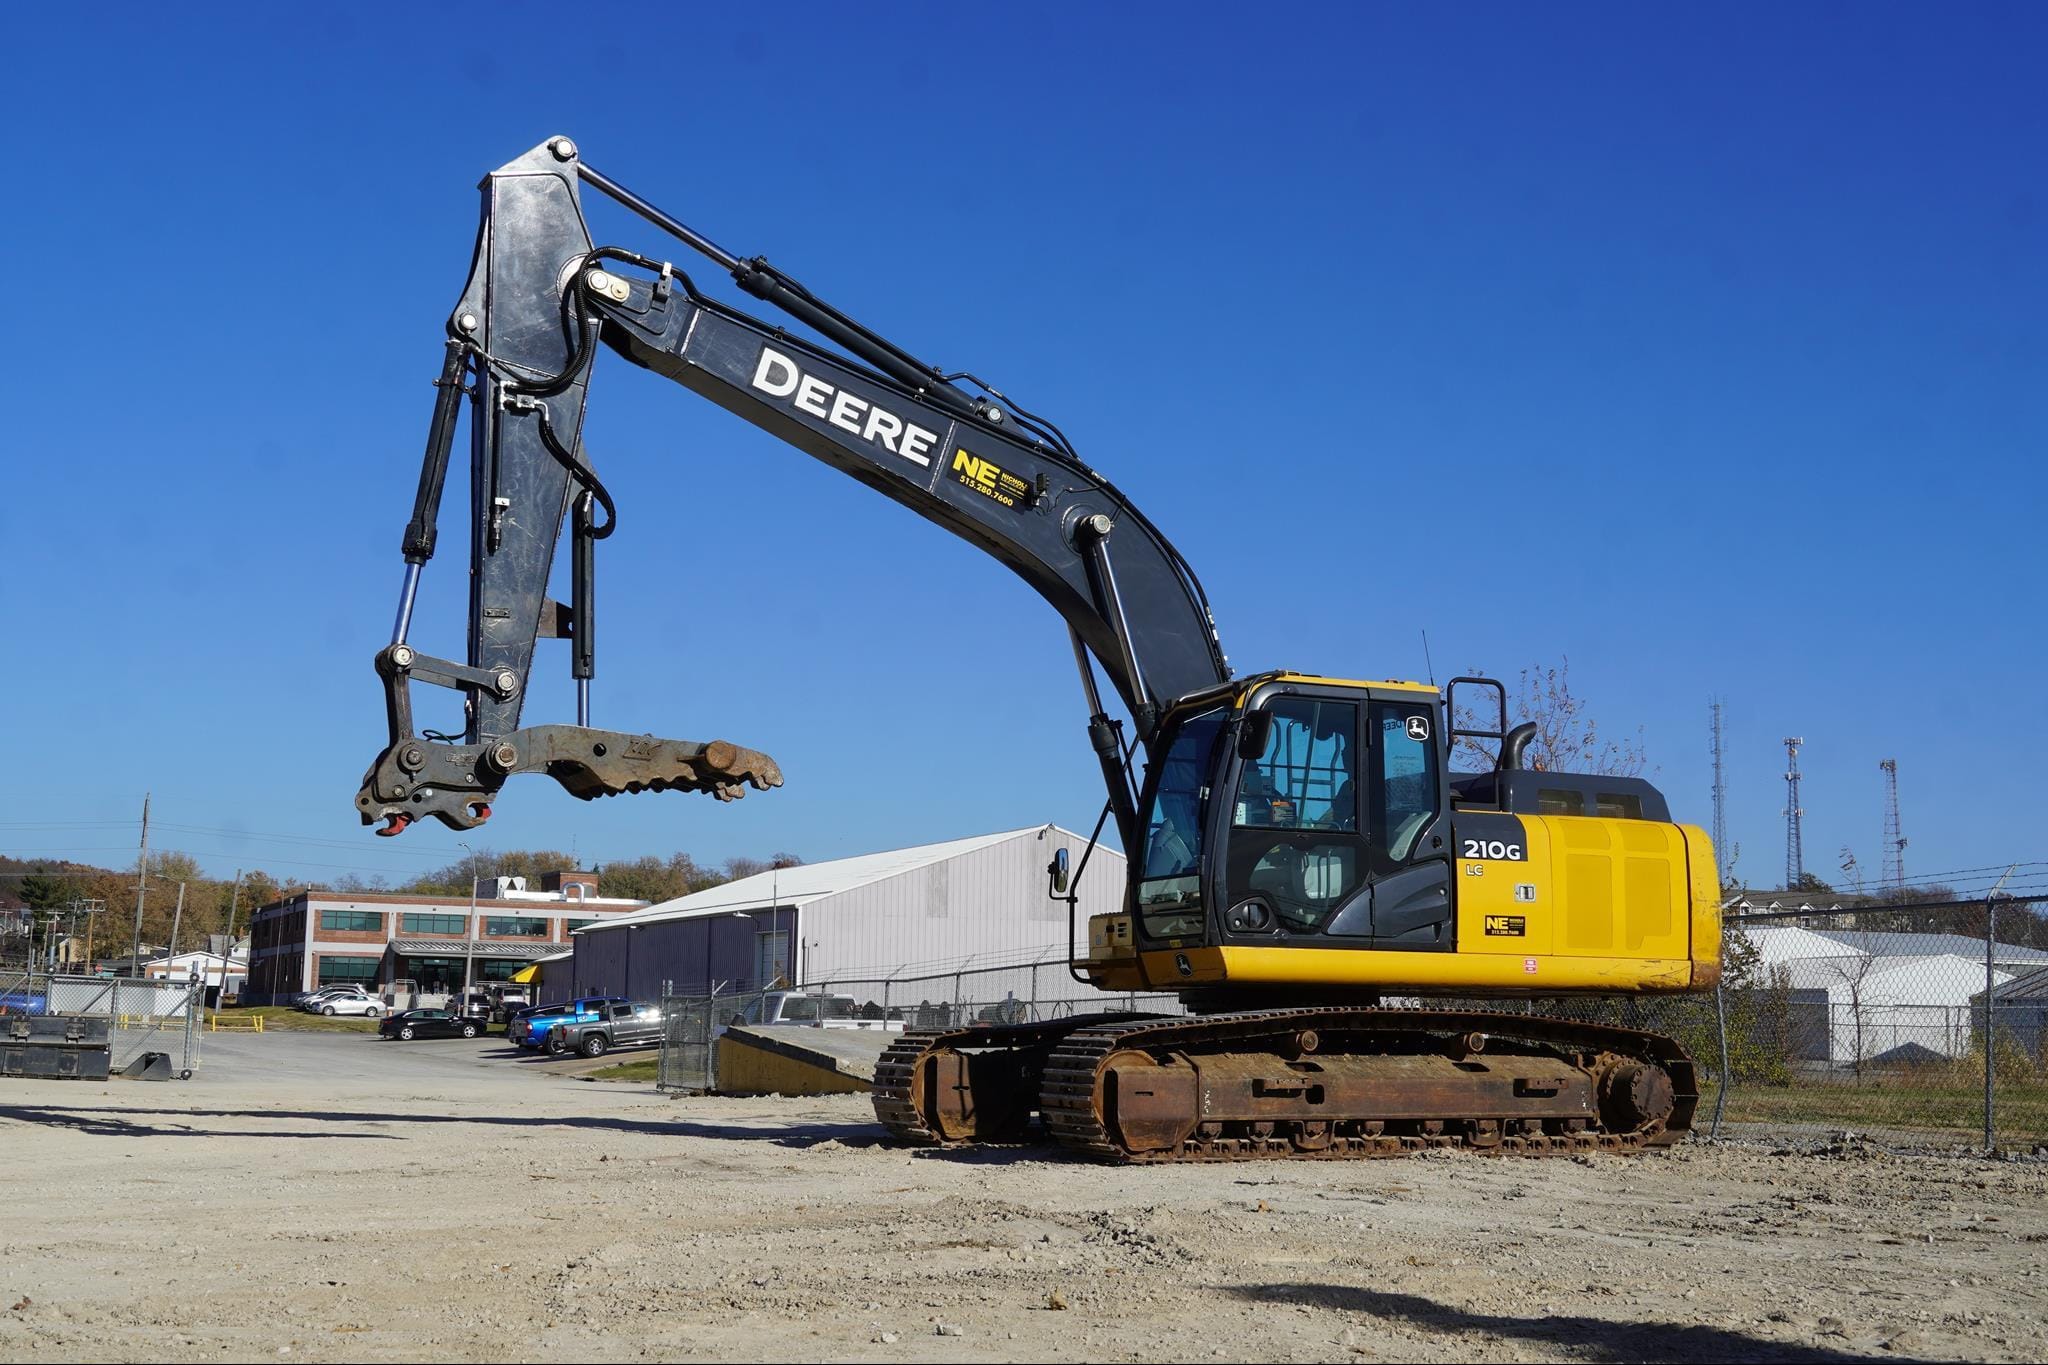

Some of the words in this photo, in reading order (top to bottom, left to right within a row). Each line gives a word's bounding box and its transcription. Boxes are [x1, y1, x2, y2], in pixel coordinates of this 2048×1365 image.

[751, 347, 938, 468] DEERE
[952, 448, 1001, 489] NE
[959, 474, 1014, 507] 515.280.7600
[1463, 839, 1521, 861] 210G
[1465, 863, 1484, 876] LC
[1486, 916, 1509, 930] NE
